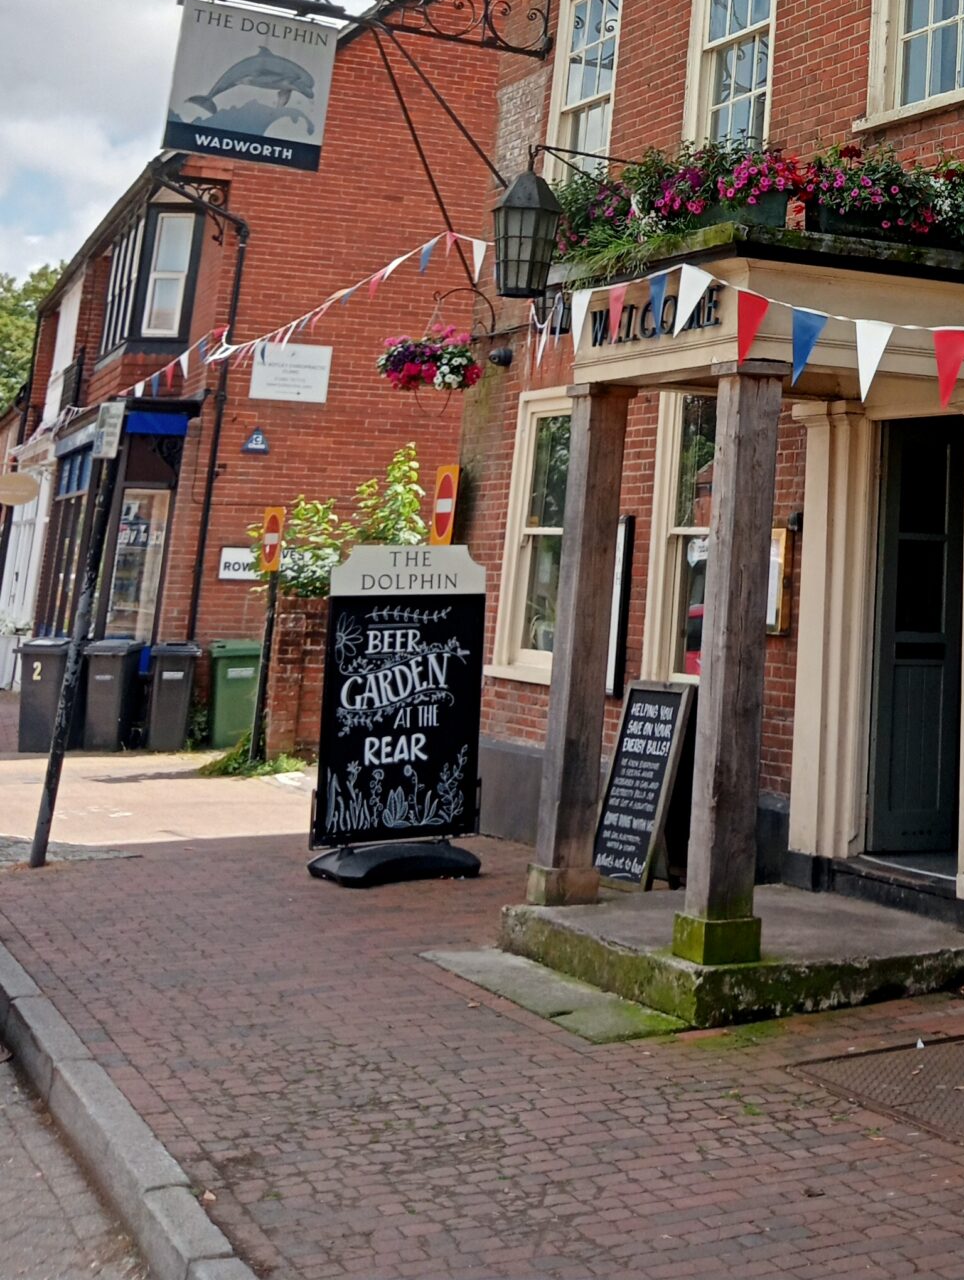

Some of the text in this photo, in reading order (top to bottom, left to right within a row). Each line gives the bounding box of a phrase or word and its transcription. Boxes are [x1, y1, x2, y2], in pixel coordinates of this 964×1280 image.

[193, 8, 330, 47] THE DOLPHIN
[195, 133, 293, 160] WADWORTH
[390, 551, 432, 567] THE
[361, 573, 459, 591] DOLPHIN
[365, 629, 422, 655] BEER
[32, 661, 42, 681] 2
[340, 652, 452, 710] GARDEN
[393, 704, 440, 729] AT THE
[631, 703, 658, 718] HELPING
[627, 720, 672, 738] SAVE ON YOUR
[364, 732, 428, 766] REAR
[623, 738, 670, 756] ENERGY BILLS!
